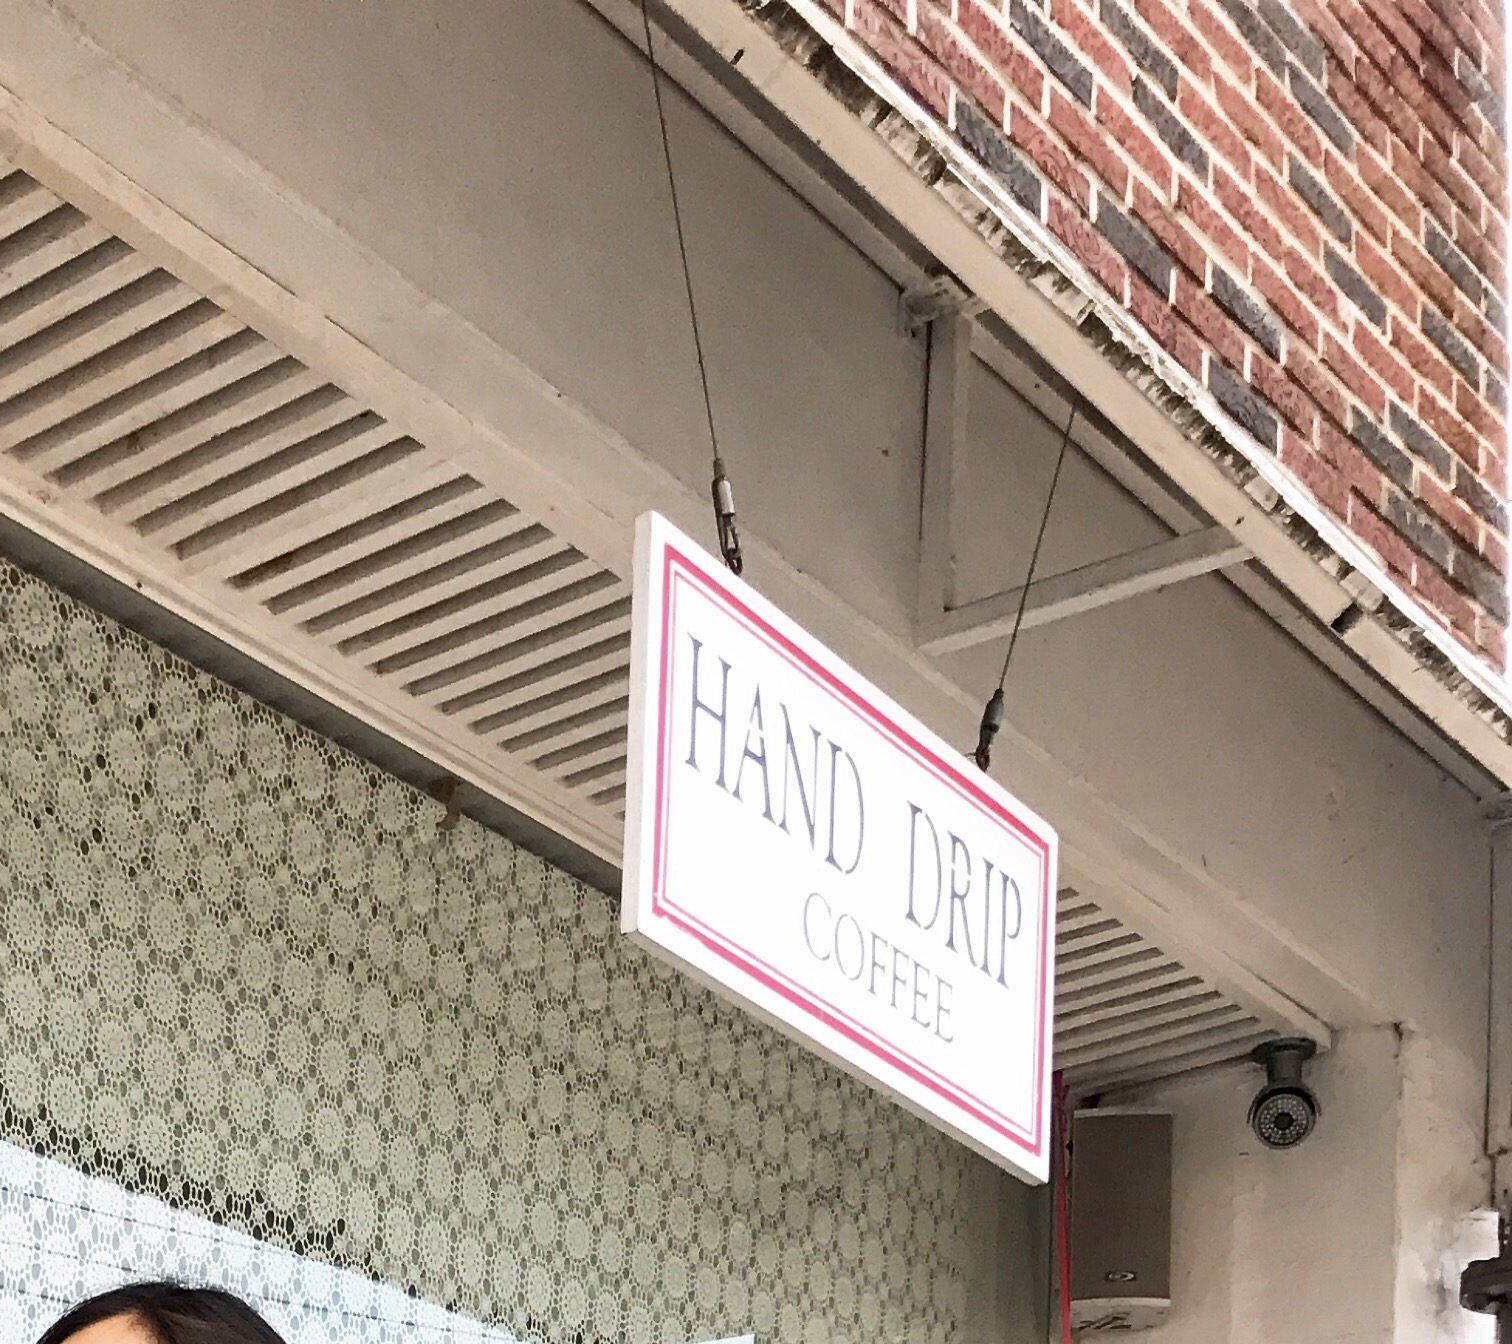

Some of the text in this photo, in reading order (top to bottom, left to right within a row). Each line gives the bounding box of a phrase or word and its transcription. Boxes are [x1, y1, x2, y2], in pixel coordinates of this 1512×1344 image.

[685, 631, 1022, 989] HAND DRIP
[802, 892, 955, 1044] COFFEE
